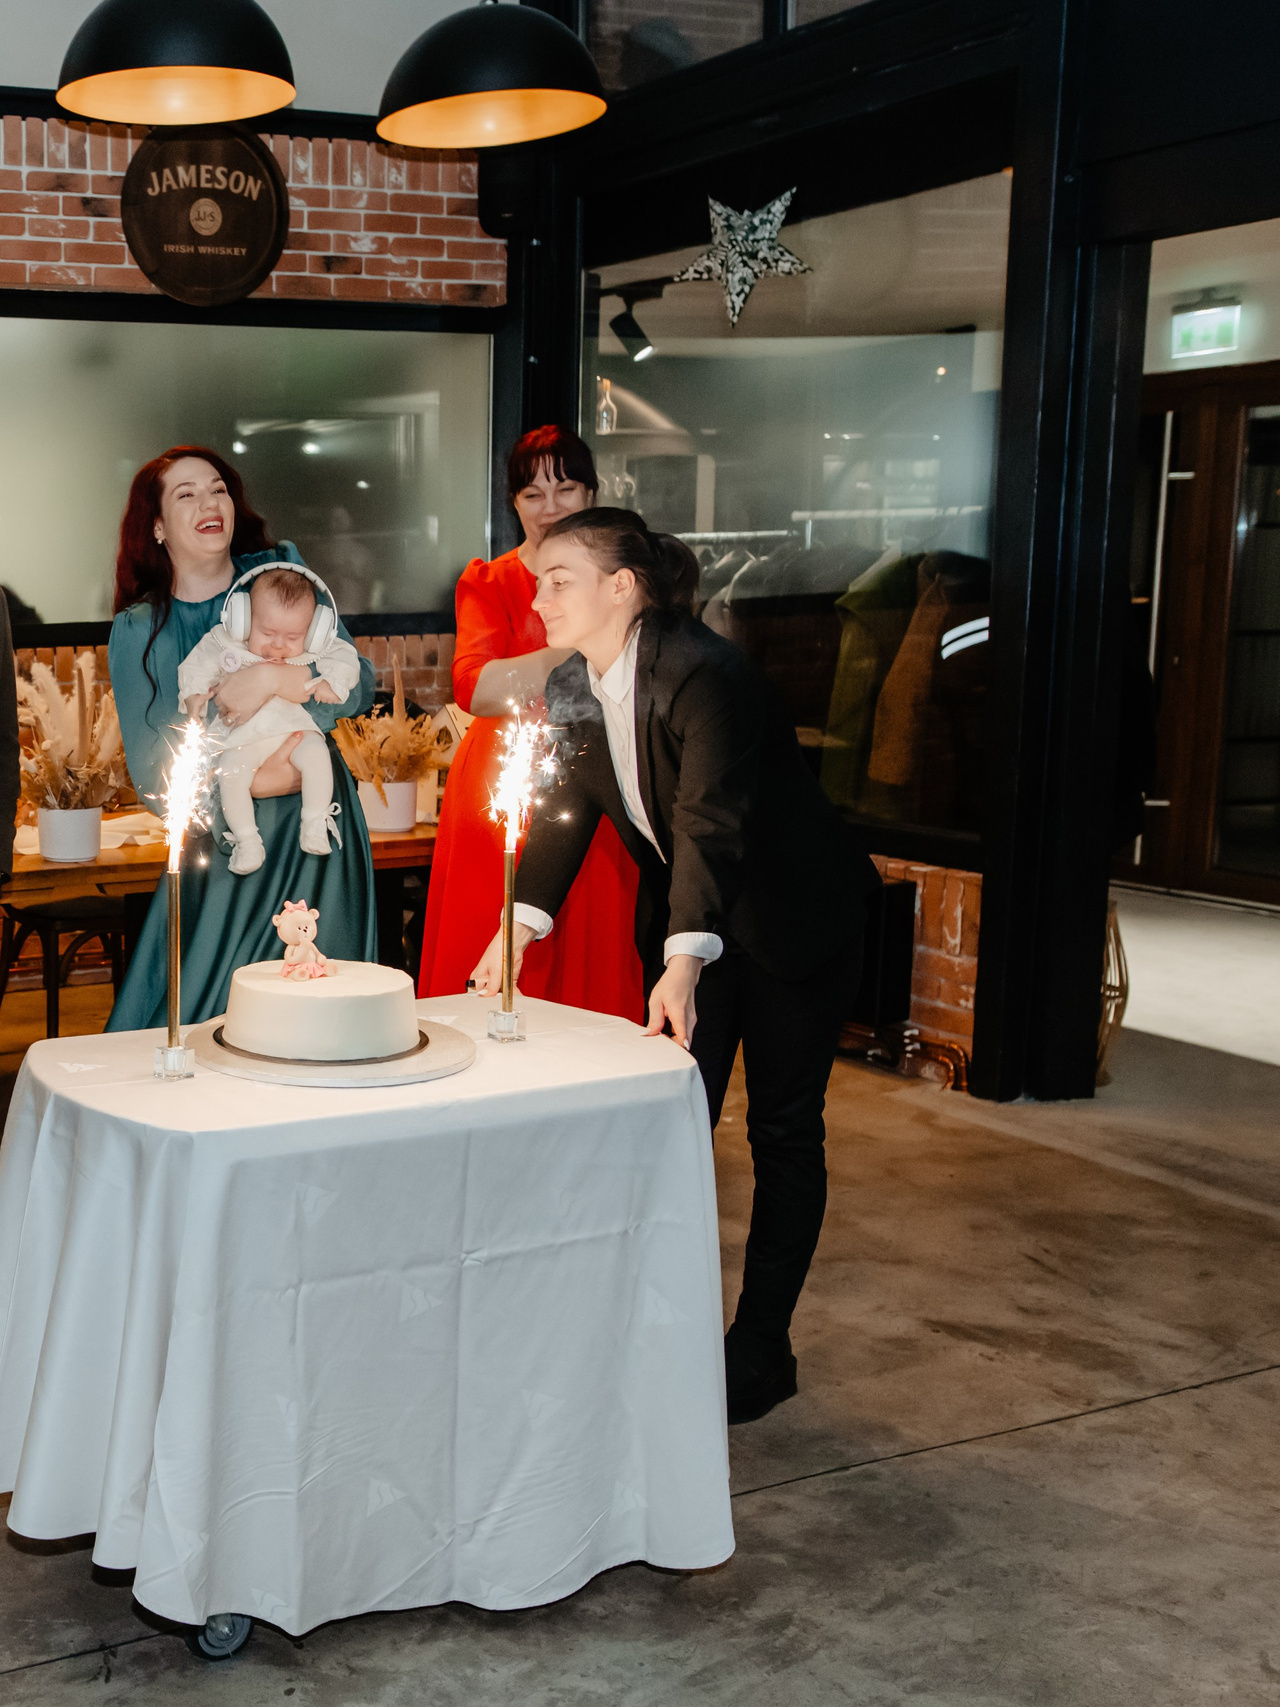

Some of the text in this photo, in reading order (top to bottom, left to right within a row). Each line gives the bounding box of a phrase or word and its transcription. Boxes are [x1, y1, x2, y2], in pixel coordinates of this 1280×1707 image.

[147, 165, 262, 201] JAMESON
[164, 244, 247, 256] IRISH WHISKEY
